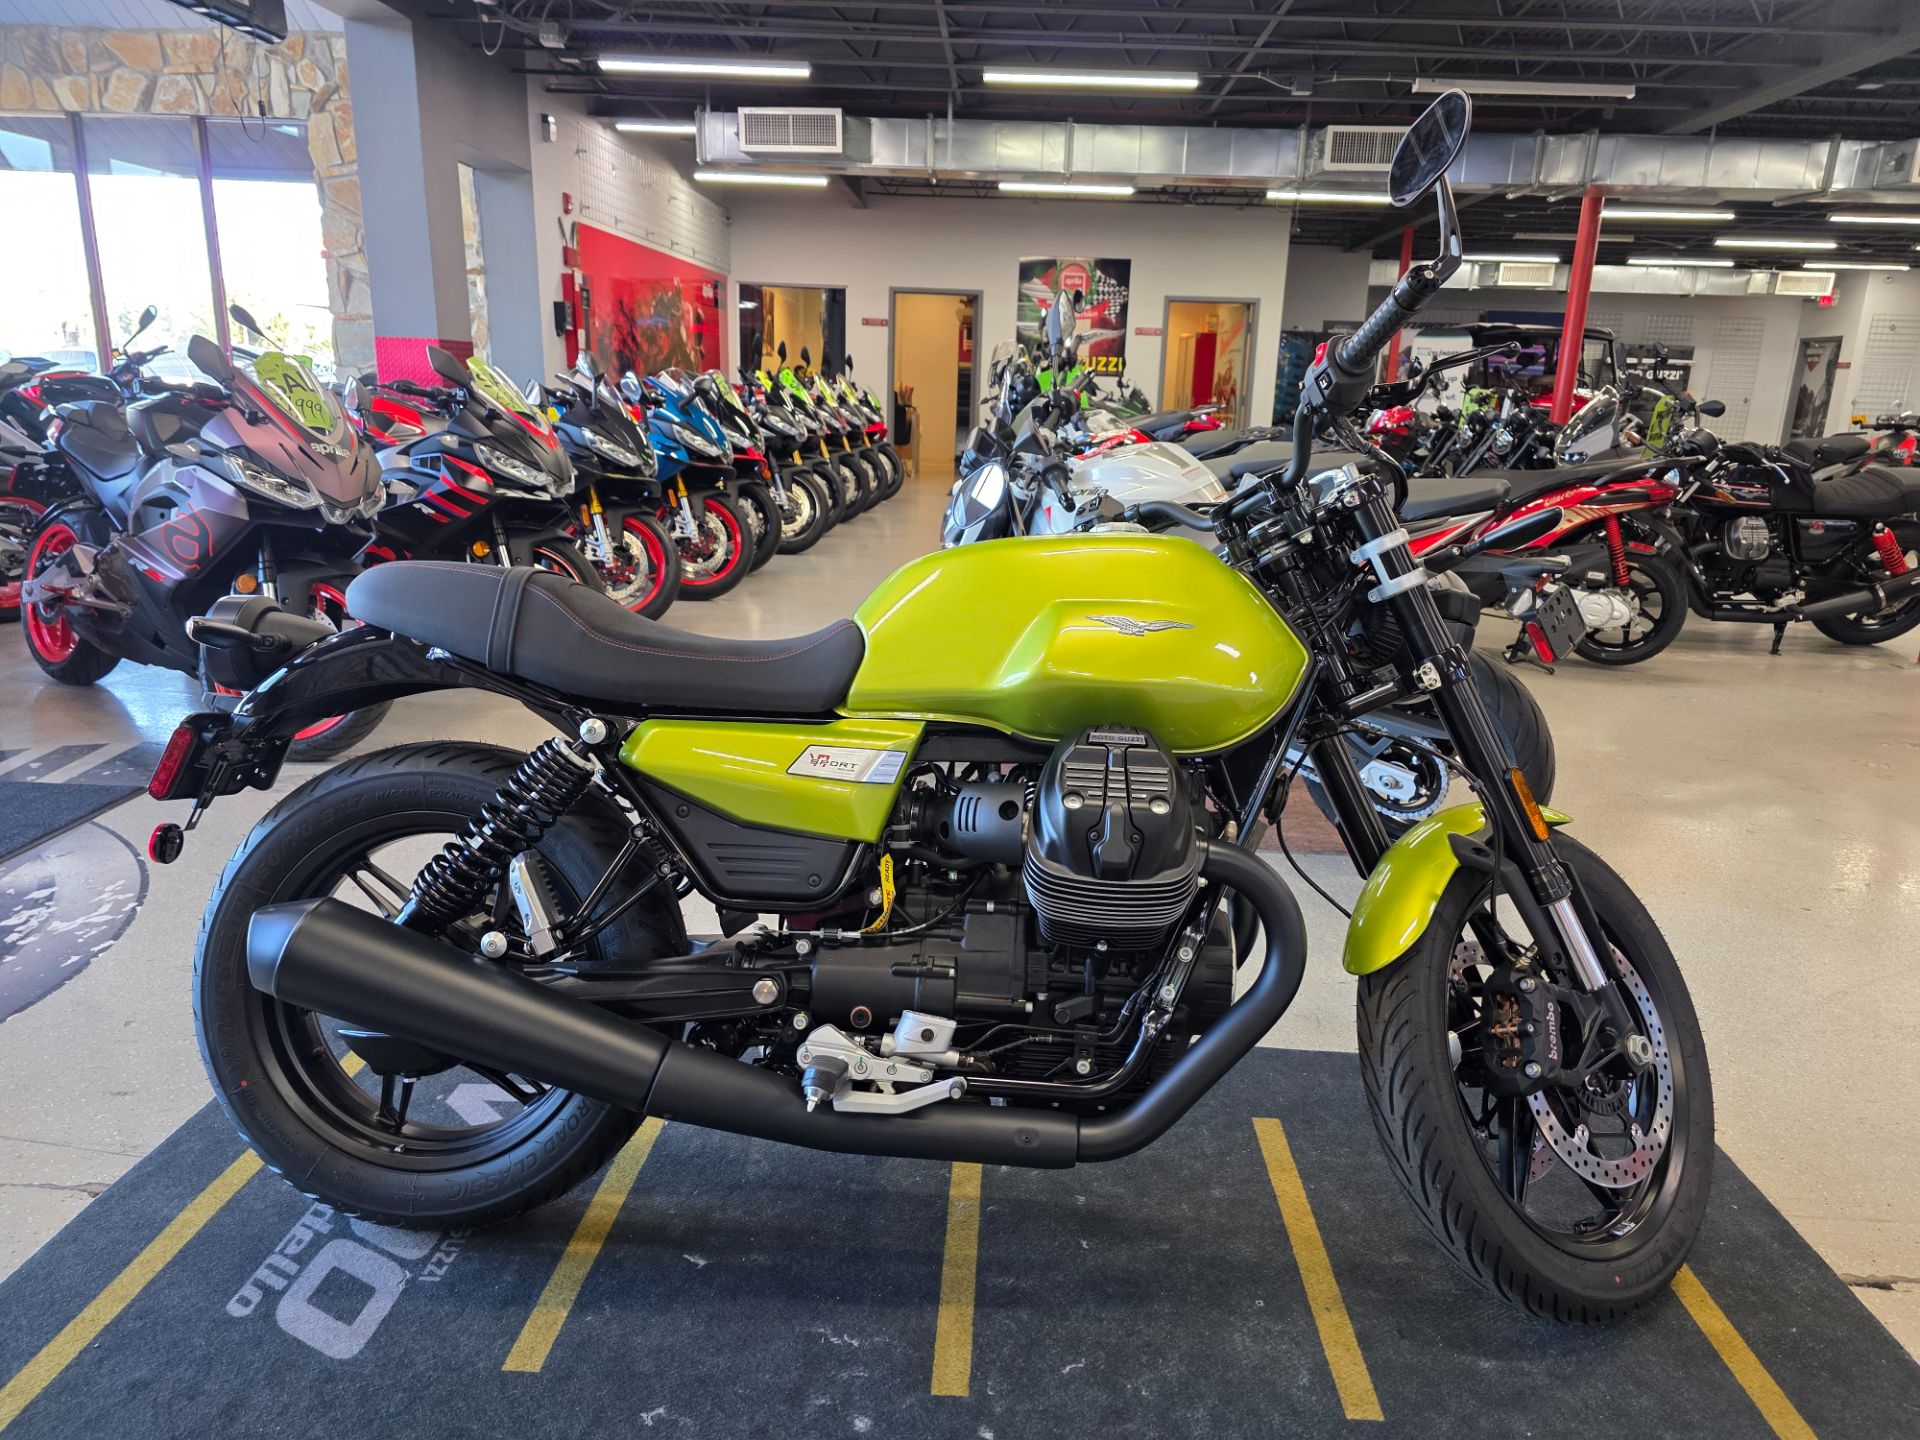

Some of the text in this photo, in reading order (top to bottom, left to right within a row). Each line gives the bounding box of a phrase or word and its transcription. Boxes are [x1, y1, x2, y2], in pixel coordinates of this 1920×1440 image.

[310, 442, 351, 458] aprilia
[1118, 735, 1144, 743] GUZZI
[809, 758, 859, 770] SPORT
[1546, 1001, 1558, 1061] brembo
[225, 1202, 336, 1318] dello
